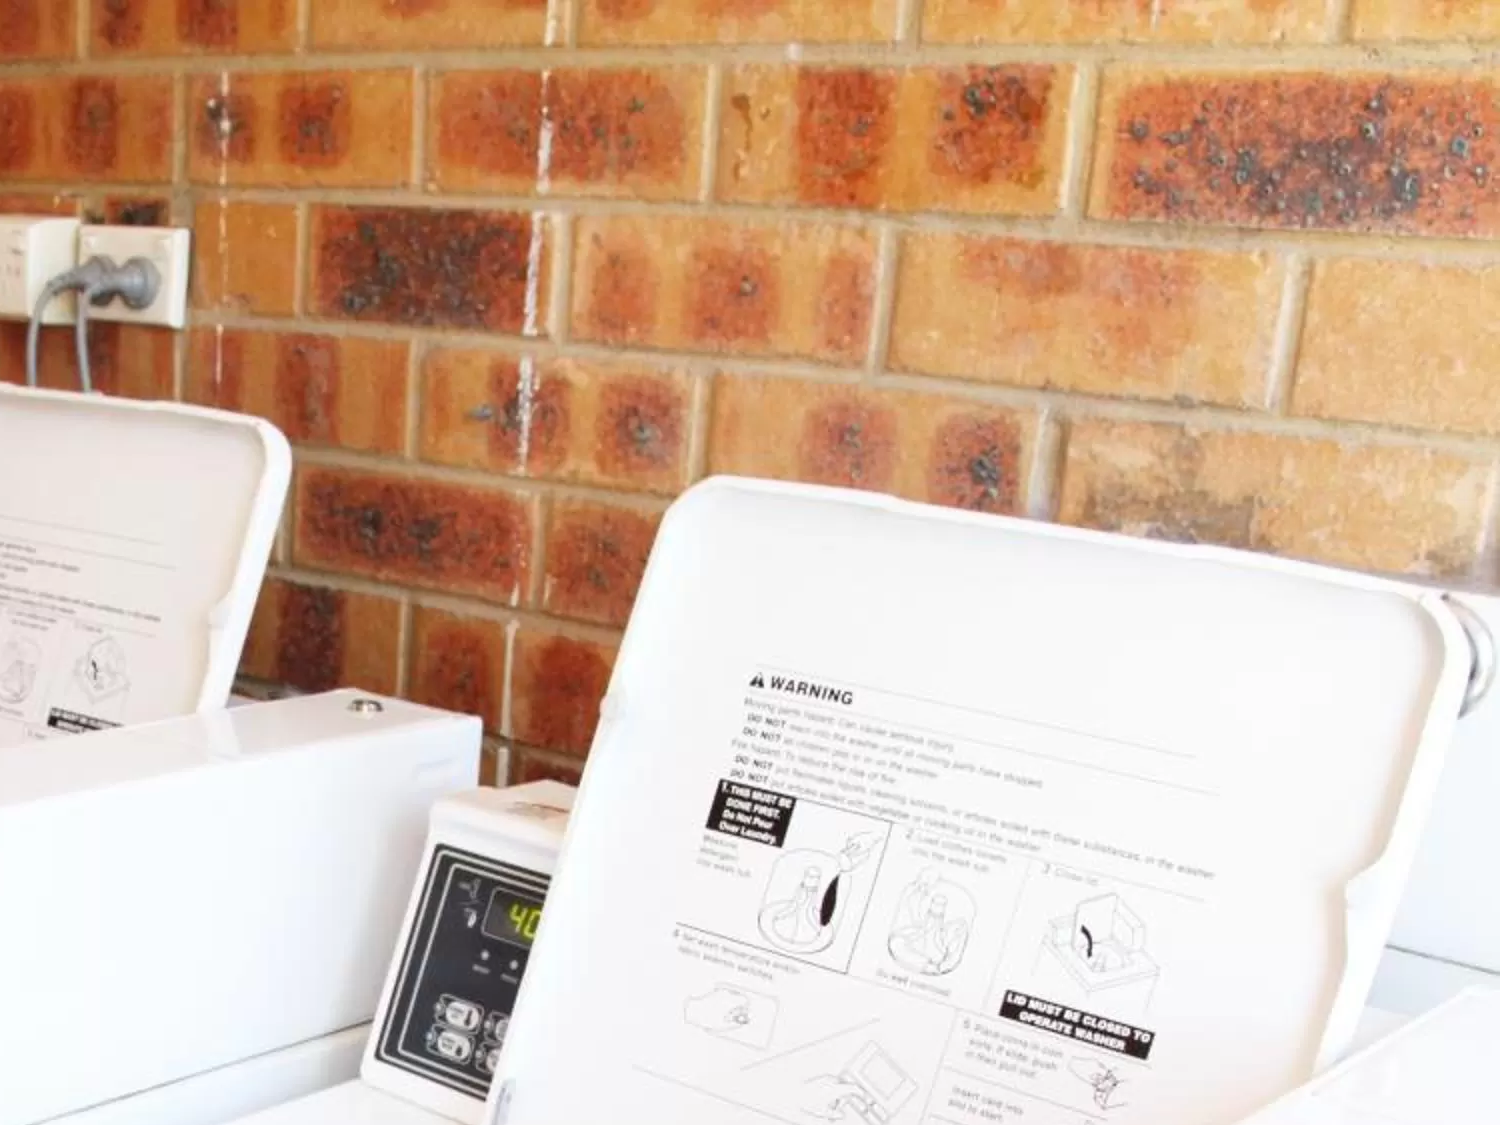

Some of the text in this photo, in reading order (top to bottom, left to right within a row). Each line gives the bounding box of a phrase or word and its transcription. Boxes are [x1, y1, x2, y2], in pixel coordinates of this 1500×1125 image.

[770, 674, 853, 704] WARNING
[765, 716, 785, 728] NOT
[760, 730, 781, 743] NOT
[753, 759, 772, 771] NOT
[748, 772, 768, 784] NOT
[731, 786, 749, 798] THIS
[752, 791, 776, 804] MUST
[779, 797, 791, 808] BE
[726, 798, 751, 811] DONE
[753, 818, 773, 829] Pour
[1007, 993, 1150, 1043] LID MUST BE CLOSED TO
[1019, 1012, 1125, 1051] OPERATE WASHER
